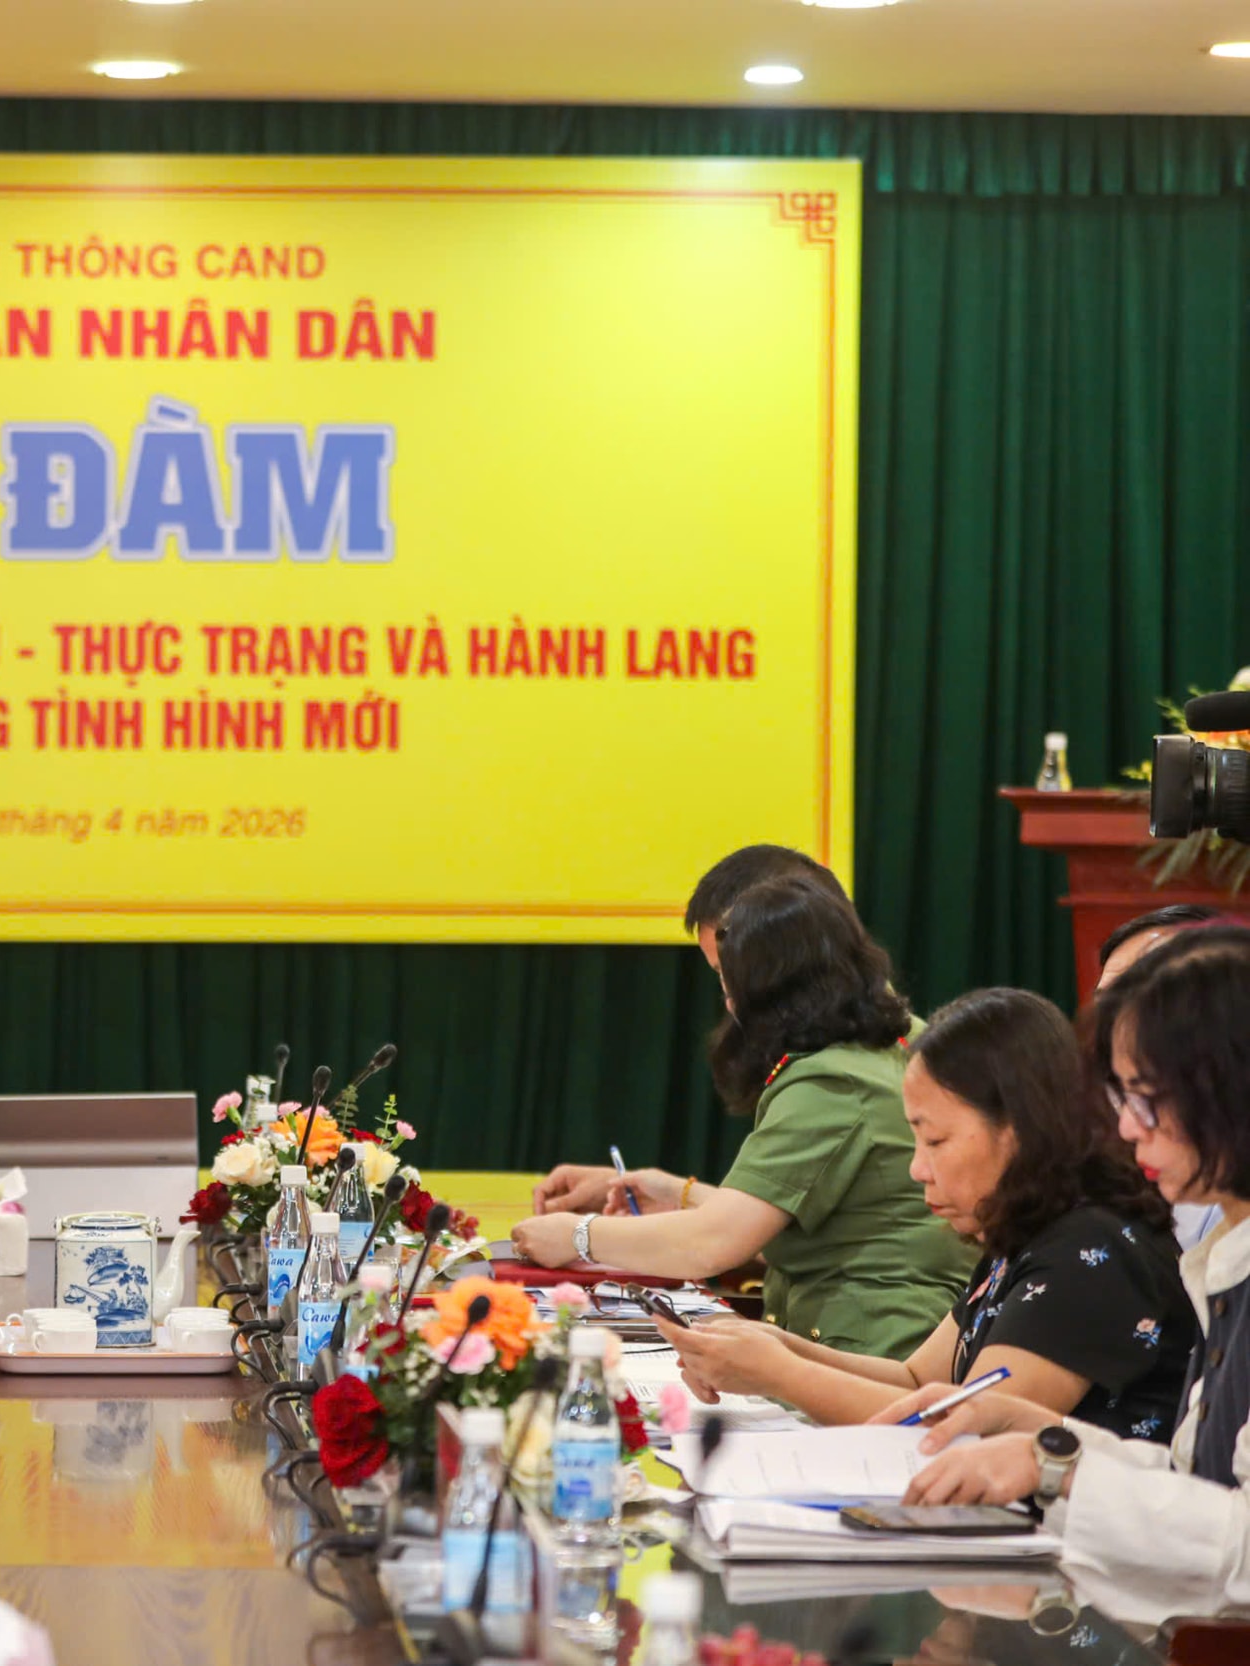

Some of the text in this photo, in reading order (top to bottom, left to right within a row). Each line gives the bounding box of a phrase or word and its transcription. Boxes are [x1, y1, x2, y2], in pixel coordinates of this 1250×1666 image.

[14, 234, 179, 279] THÔNG
[196, 243, 327, 279] CAND
[78, 297, 270, 359] NHÂN
[296, 297, 437, 360] DÂN
[53, 618, 182, 687] THỰC
[200, 626, 368, 688] TRẠNG
[386, 615, 450, 677] VÀ
[468, 616, 607, 678] HÀNH
[626, 628, 757, 680] LANG
[28, 687, 144, 750] TÌNH
[162, 688, 285, 750] HÌNH
[303, 689, 400, 752] MỚI
[103, 807, 124, 834] 4
[135, 806, 210, 838] năm
[219, 806, 307, 839] 2026
